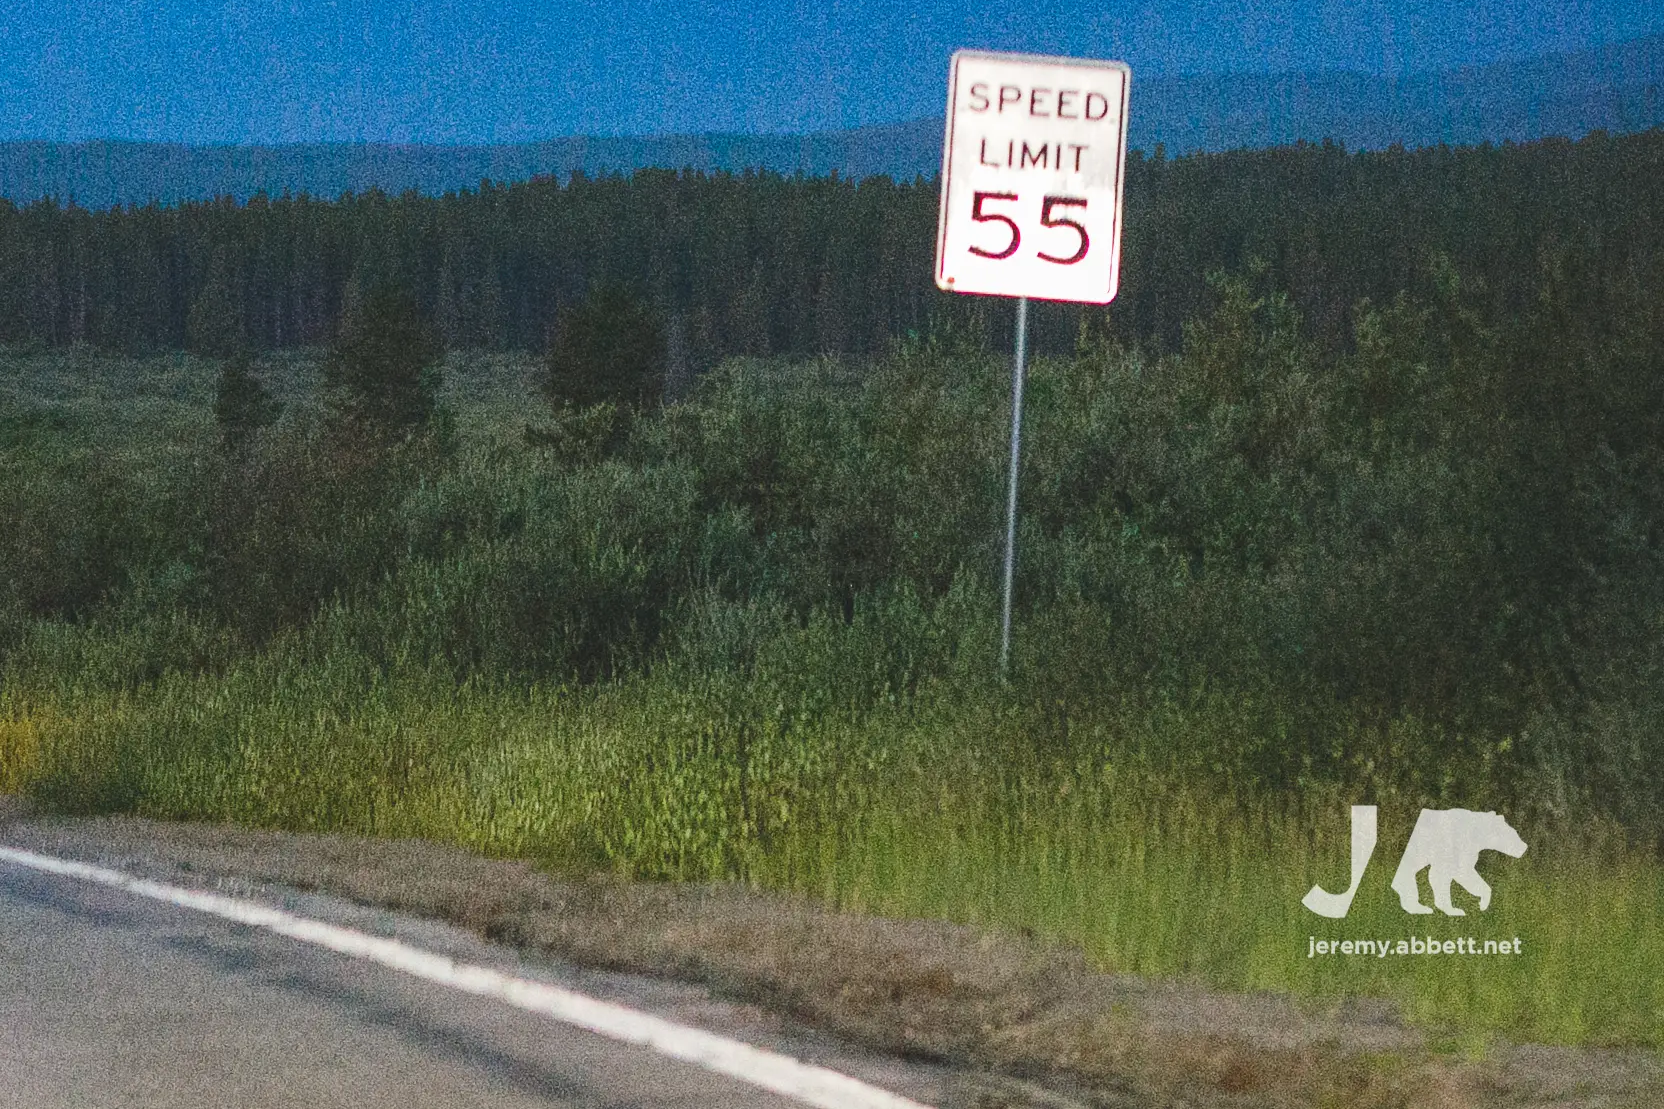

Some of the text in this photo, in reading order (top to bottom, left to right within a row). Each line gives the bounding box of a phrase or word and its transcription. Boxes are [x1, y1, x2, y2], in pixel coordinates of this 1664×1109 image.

[968, 81, 1109, 121] SPEED
[979, 136, 1090, 174] LIMIT
[967, 190, 1090, 265] 55
